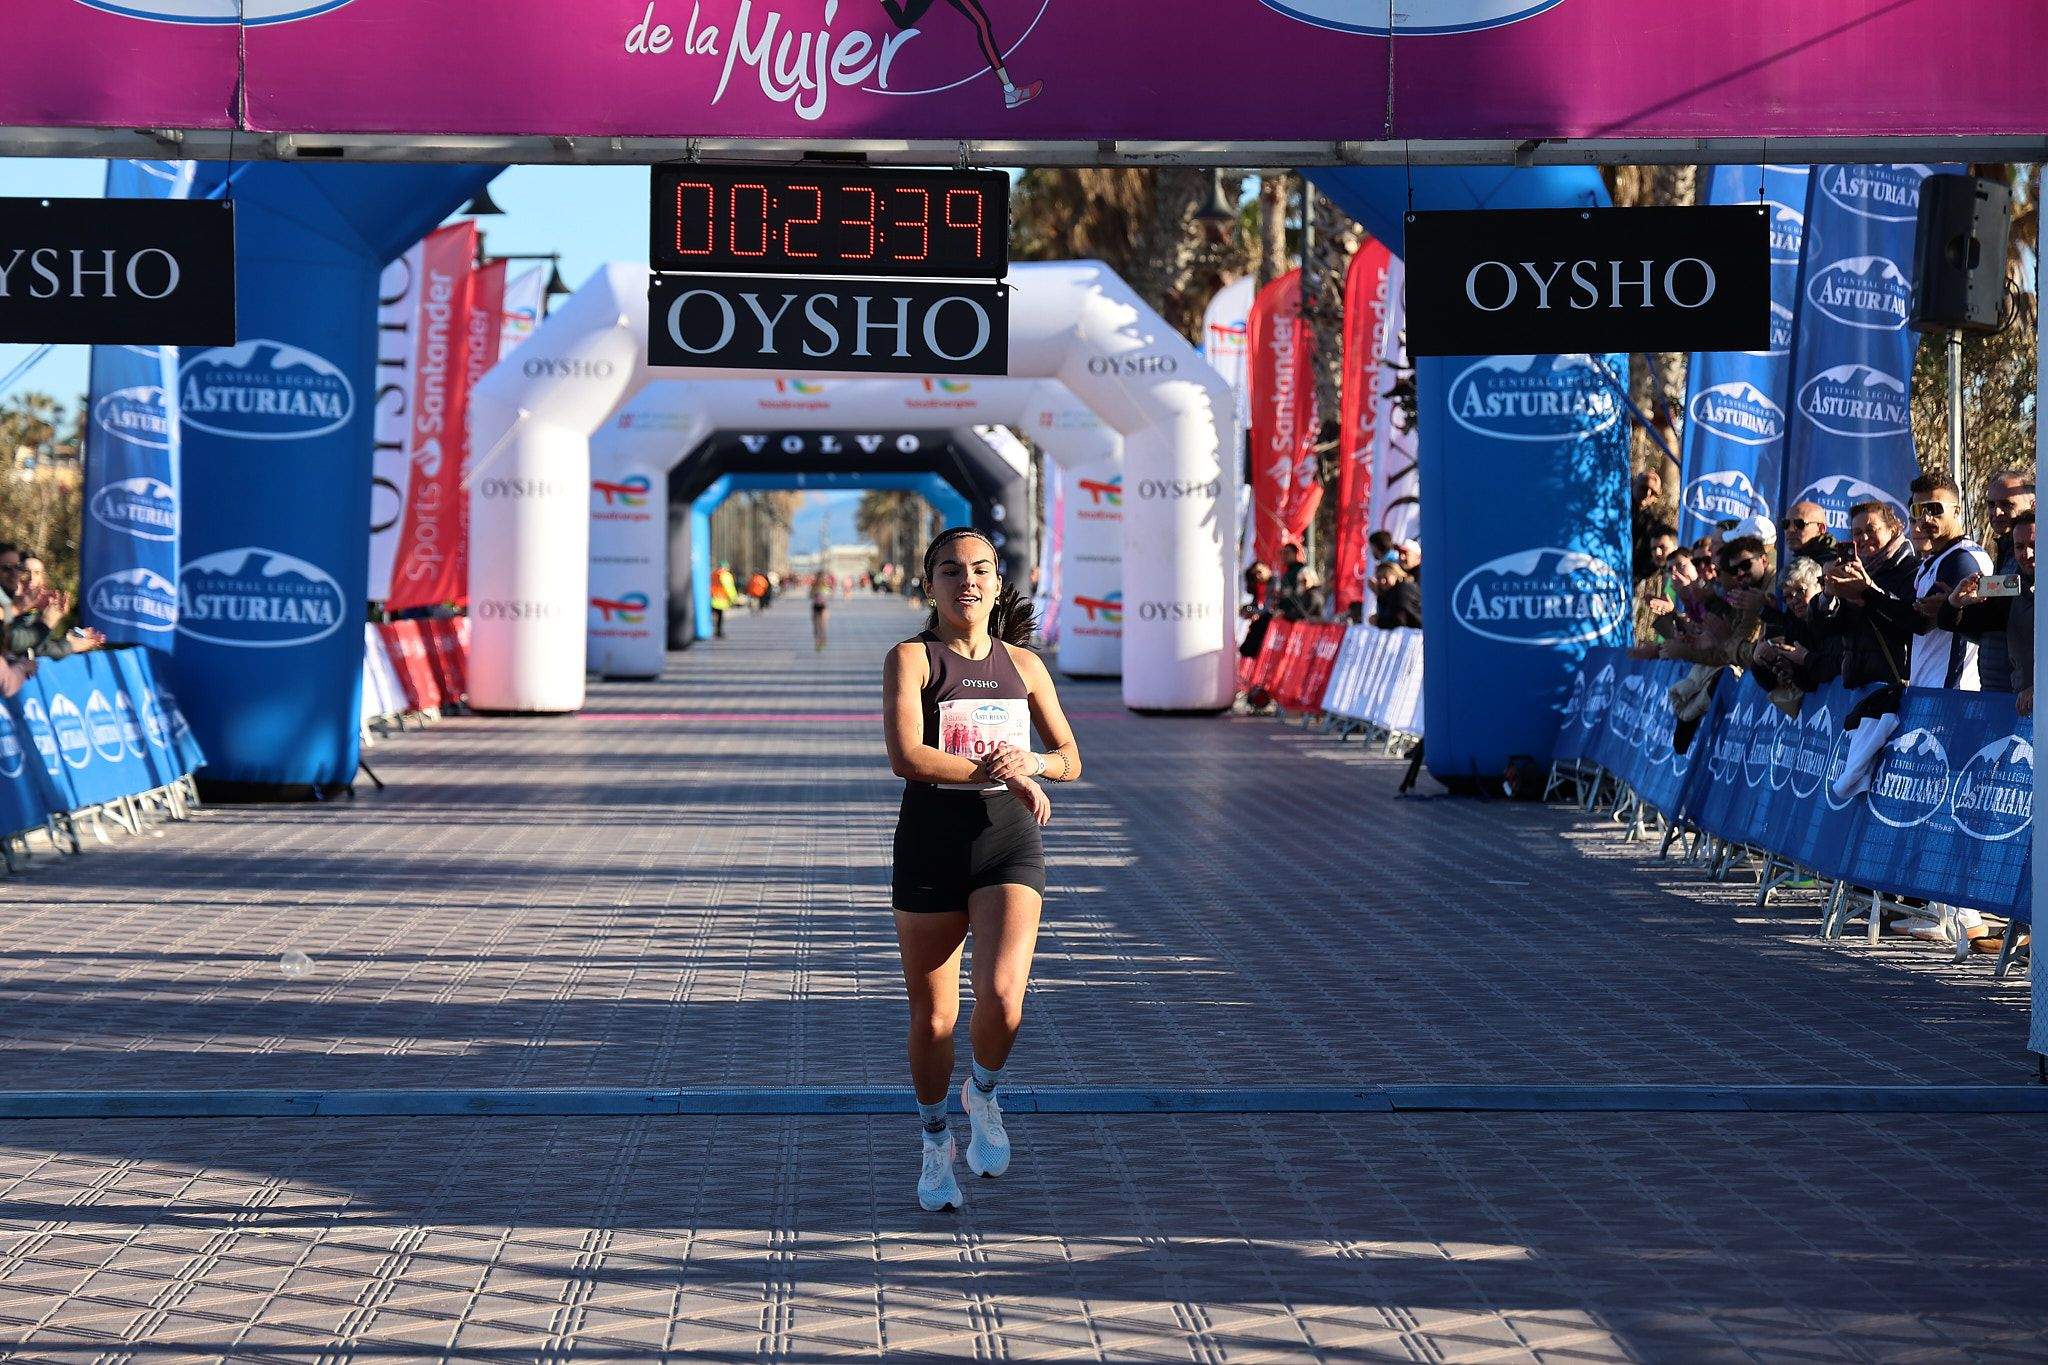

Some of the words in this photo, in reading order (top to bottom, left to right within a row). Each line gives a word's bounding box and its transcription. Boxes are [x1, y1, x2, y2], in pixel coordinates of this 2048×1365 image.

[624, 1, 674, 55] de
[684, 1, 719, 55] la
[711, 0, 921, 120] Mujer
[1831, 166, 1920, 208] ASTURIAN
[676, 182, 983, 259] 00:23:39
[0, 248, 180, 299] YSHO
[1465, 258, 1716, 311] OYSHO
[666, 289, 991, 361] OYSHO
[416, 271, 453, 434] Santander
[522, 357, 614, 380] OYSHO
[1087, 355, 1178, 377] OYSHO
[182, 373, 343, 419] ASTURIANA
[1270, 312, 1295, 451] Santander
[739, 434, 920, 454] VOLVO
[1138, 479, 1222, 499] OYSHO
[406, 481, 444, 582] Sports
[179, 582, 336, 625] ASTURIANA
[1139, 600, 1212, 621] OYSH
[962, 679, 998, 689] OYSHO
[1871, 759, 1941, 805] ASTURIANA
[1955, 771, 2033, 817] ASTURIANA
